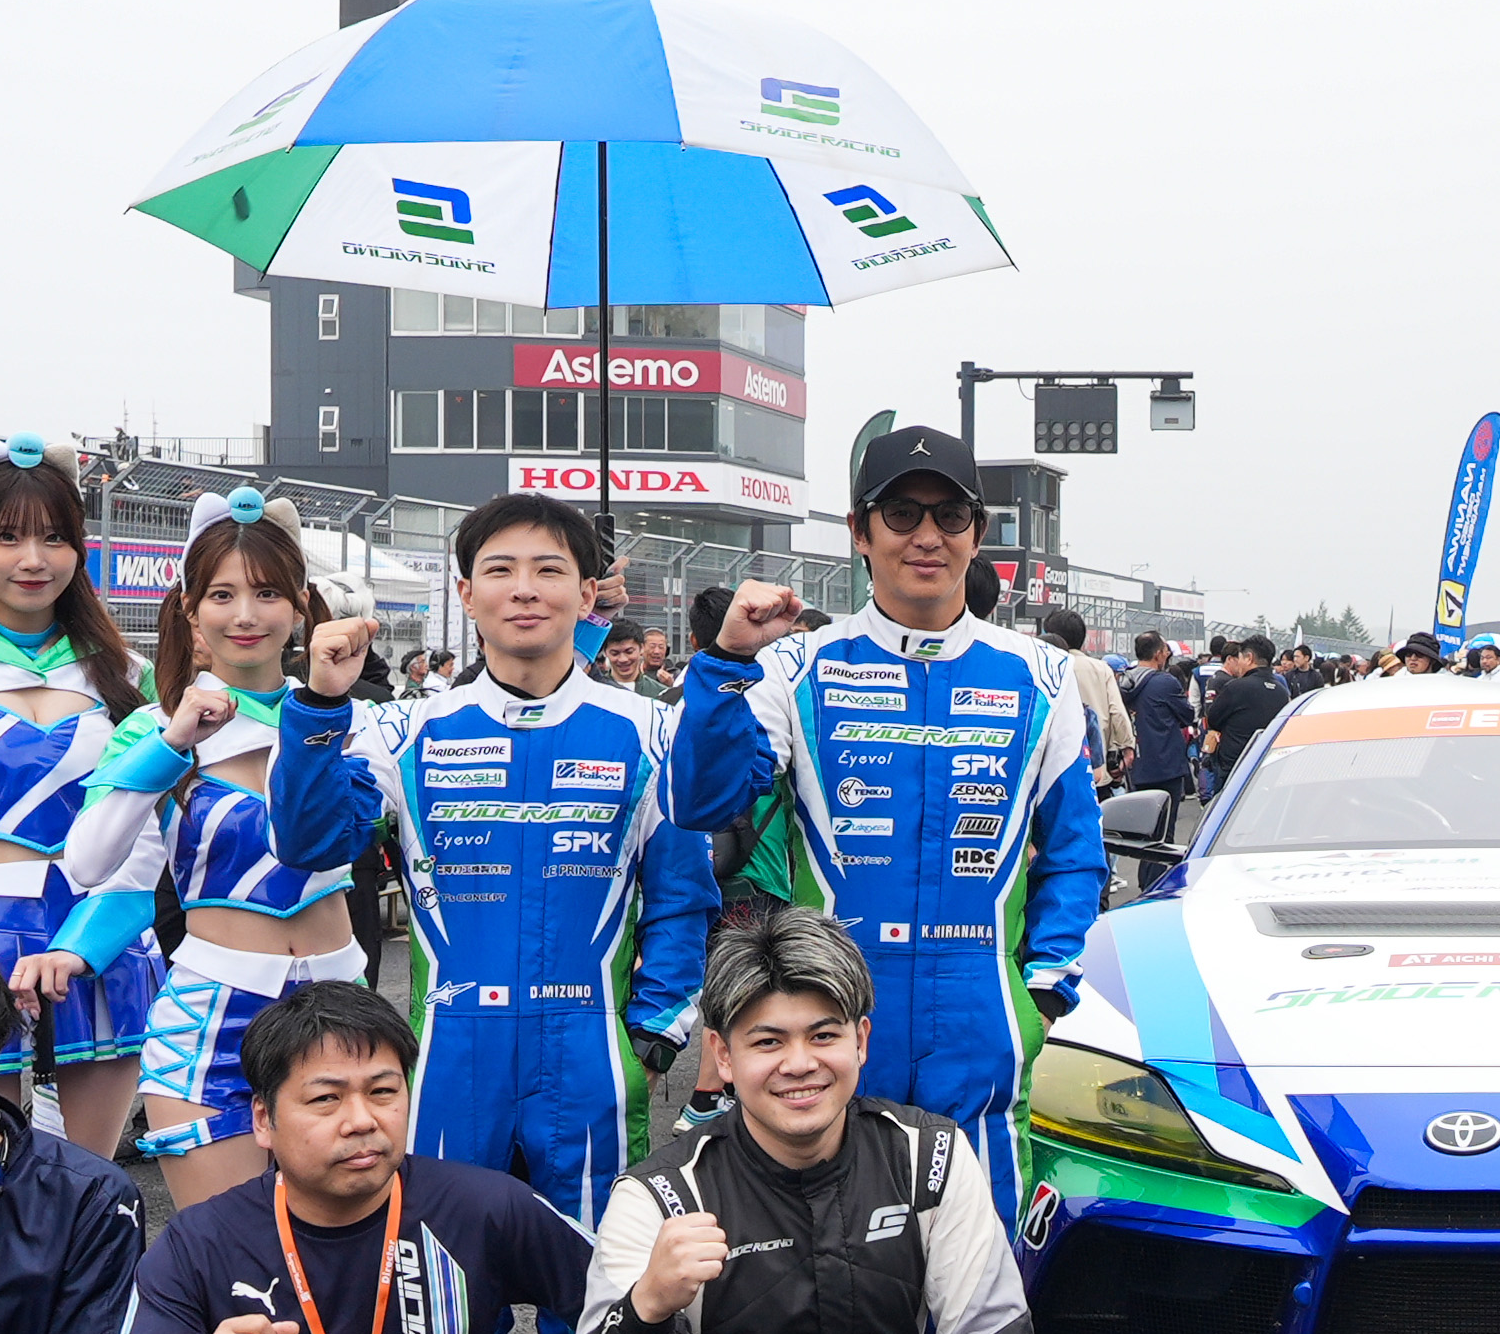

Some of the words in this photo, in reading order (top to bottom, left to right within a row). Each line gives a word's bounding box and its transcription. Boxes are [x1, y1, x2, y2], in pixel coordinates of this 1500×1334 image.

[743, 365, 787, 409] Astemo
[519, 467, 710, 493] HONDA
[741, 476, 792, 506] HONDA
[822, 665, 902, 681] BRIDGESTONE
[828, 693, 902, 706] HAYASHI
[974, 690, 1016, 701] Super
[973, 699, 1014, 709] Taikyu
[427, 745, 507, 758] BRIDGESTONE
[837, 749, 893, 768] Eyevol
[577, 762, 622, 774] Super
[951, 753, 1008, 778] SPK
[427, 772, 502, 783] HAYASHI
[577, 771, 621, 782] Taikyu
[951, 784, 1006, 798] ZENAQ
[434, 830, 492, 850] Eyevol
[552, 831, 612, 854] SPK
[955, 850, 996, 864] HDC
[559, 865, 623, 878] PRINTEMPS
[953, 866, 995, 875] CIRCUIT
[921, 924, 993, 939] K.HIRANAKA
[1441, 955, 1494, 964] AICHI
[530, 985, 592, 999] D.MIZUNO
[927, 1130, 951, 1193] sparco
[381, 1239, 396, 1284] Director
